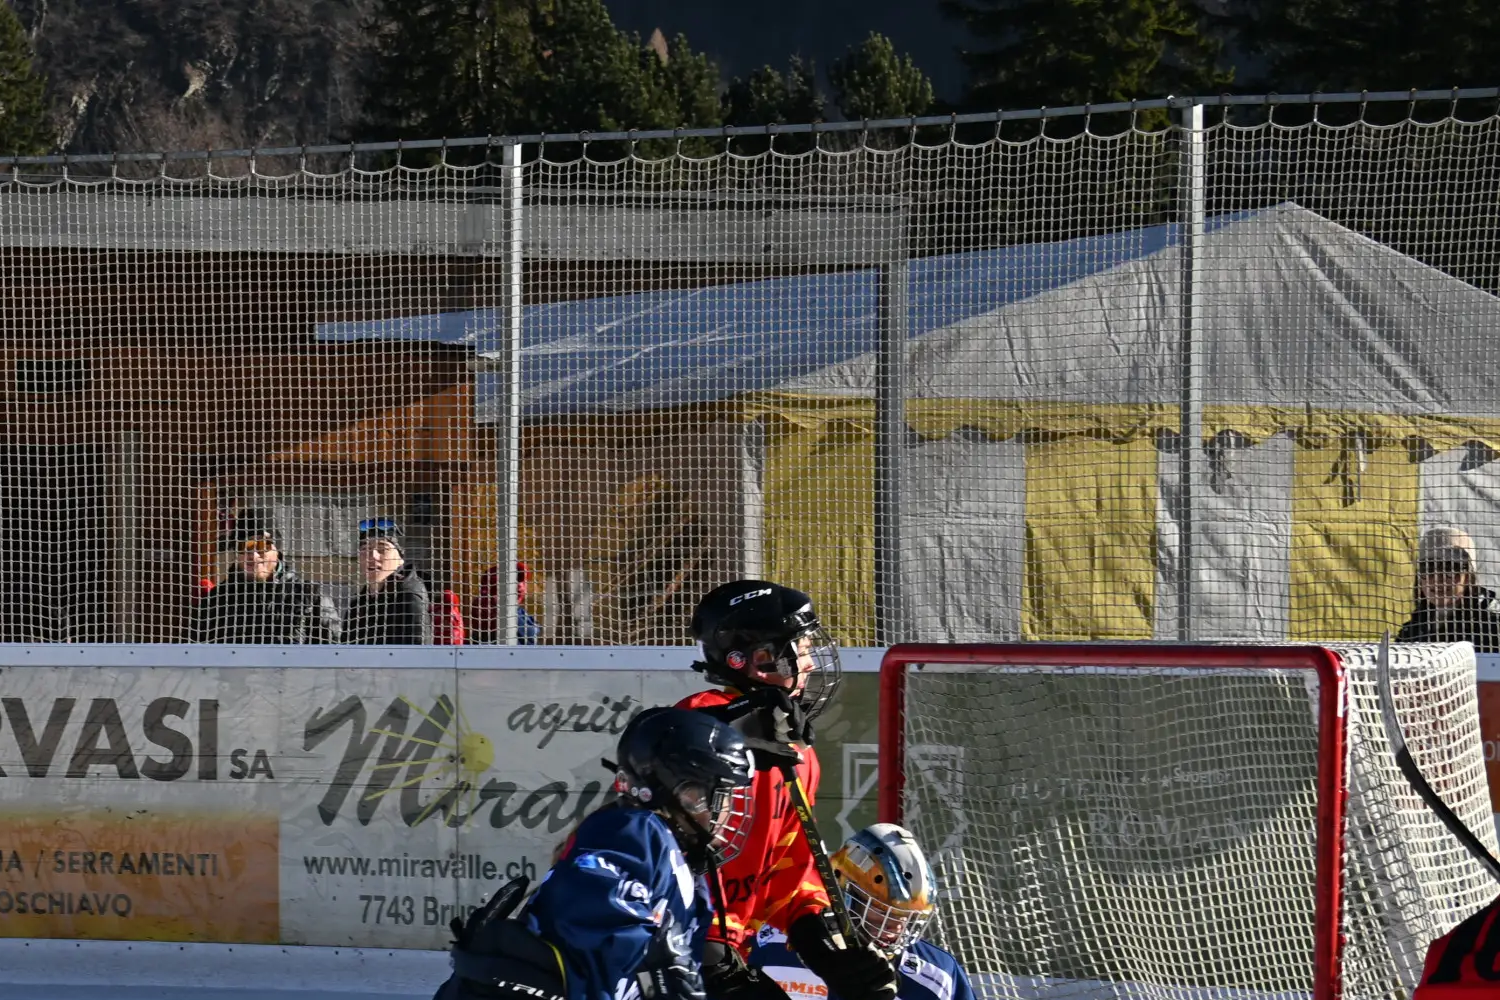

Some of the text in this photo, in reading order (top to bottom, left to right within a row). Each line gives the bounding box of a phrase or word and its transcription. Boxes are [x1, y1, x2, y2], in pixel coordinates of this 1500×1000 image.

[729, 588, 773, 606] CCM
[229, 748, 275, 781] SA
[53, 849, 219, 877] SERRAMENTI
[303, 852, 537, 881] www.miravalle.ch
[359, 894, 415, 926] 7743
